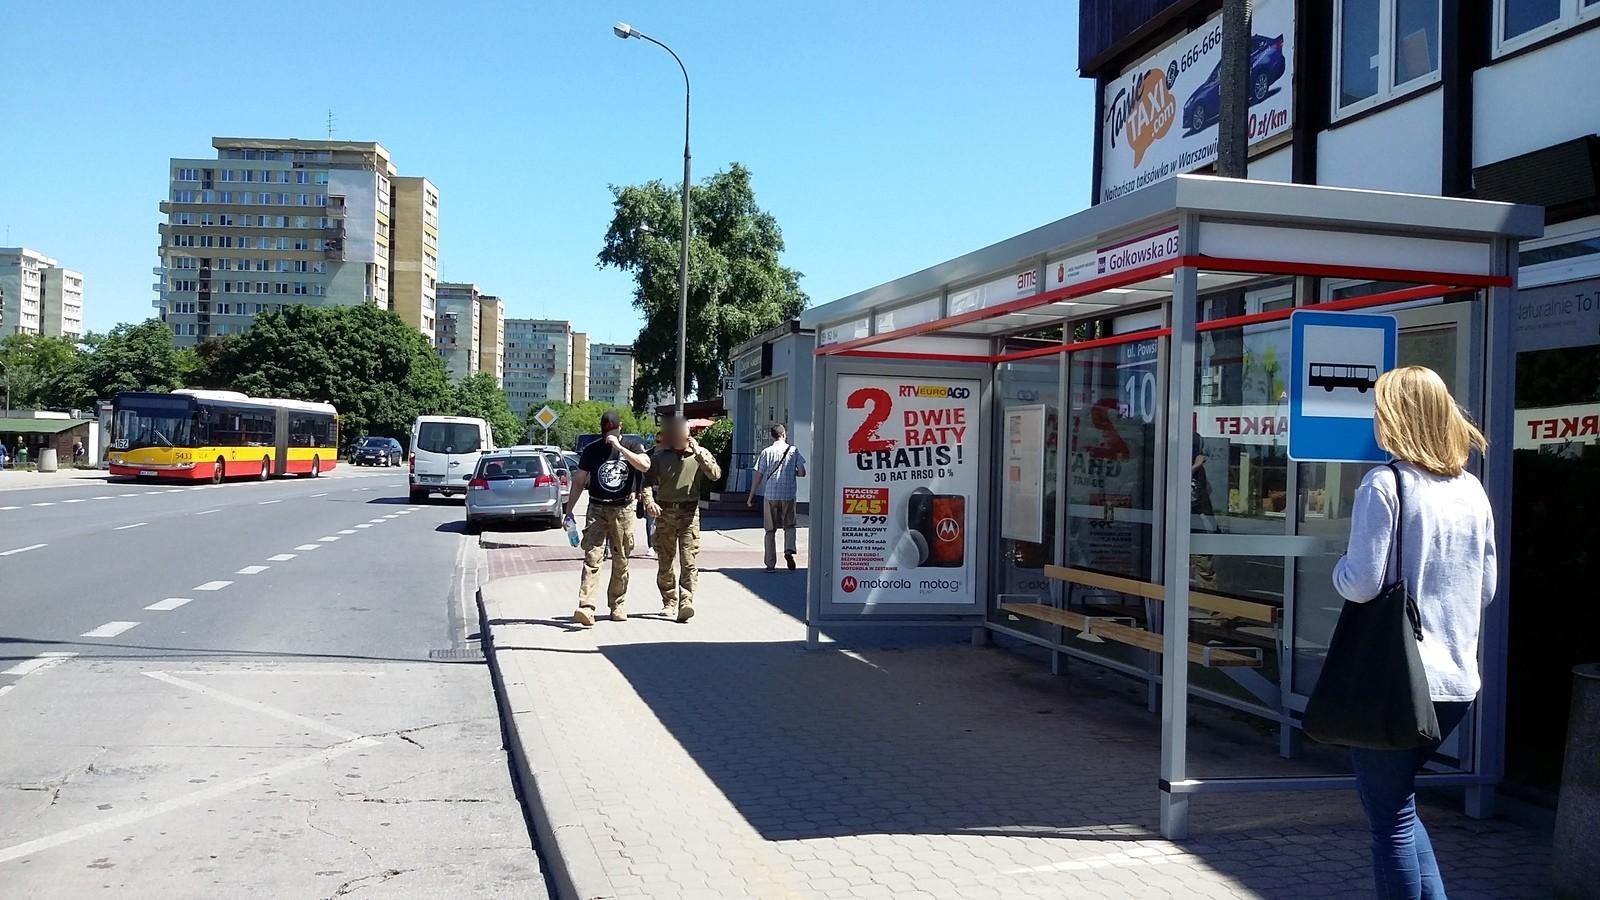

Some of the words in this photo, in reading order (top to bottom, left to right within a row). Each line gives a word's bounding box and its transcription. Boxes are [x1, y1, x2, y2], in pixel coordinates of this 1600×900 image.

[1106, 69, 1152, 148] Tanie
[1127, 79, 1165, 142] TAXI
[1257, 107, 1288, 137] zł/km
[1170, 158, 1178, 173] w
[1178, 138, 1220, 169] Warszawi
[1109, 241, 1164, 270] Gołkowska
[1166, 236, 1179, 254] 03
[1017, 269, 1036, 289] ams
[1575, 294, 1593, 312] To
[1125, 372, 1156, 423] 10
[847, 388, 897, 454] 2
[903, 408, 966, 427] DWIE
[116, 440, 128, 448] 162
[905, 427, 966, 446] RATY
[175, 452, 192, 460] 5433
[874, 473, 886, 482] 30
[890, 471, 907, 482] RAT
[845, 499, 882, 514] 745
[861, 516, 887, 525] 799
[860, 578, 911, 589] motorola
